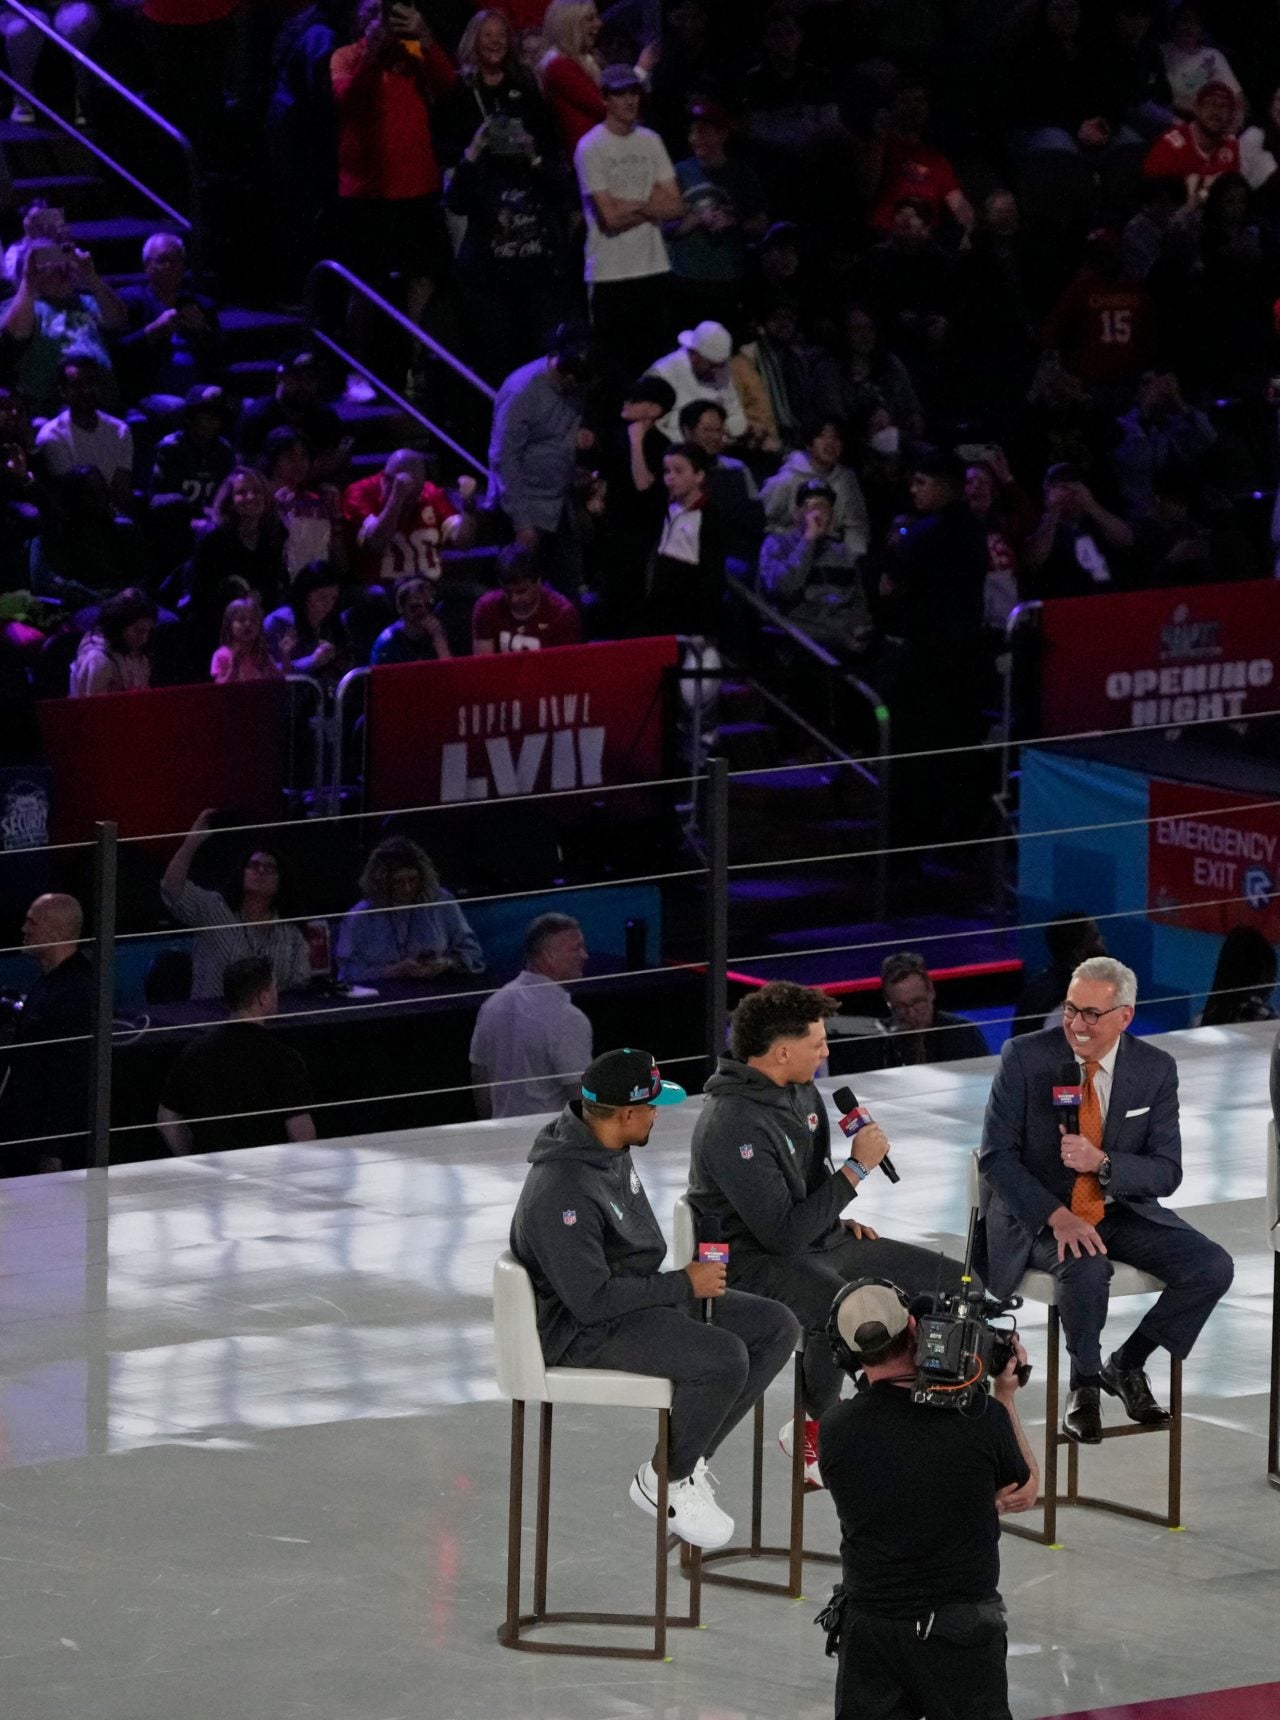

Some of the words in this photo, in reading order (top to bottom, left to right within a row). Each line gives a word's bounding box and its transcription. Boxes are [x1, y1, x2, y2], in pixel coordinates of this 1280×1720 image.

[1101, 309, 1133, 344] 15
[1105, 657, 1275, 701] OPENING
[1131, 690, 1249, 728] NIGHT
[439, 724, 607, 804] LVII
[1156, 818, 1280, 864] EMERGENCY
[1192, 855, 1239, 892] EXIT
